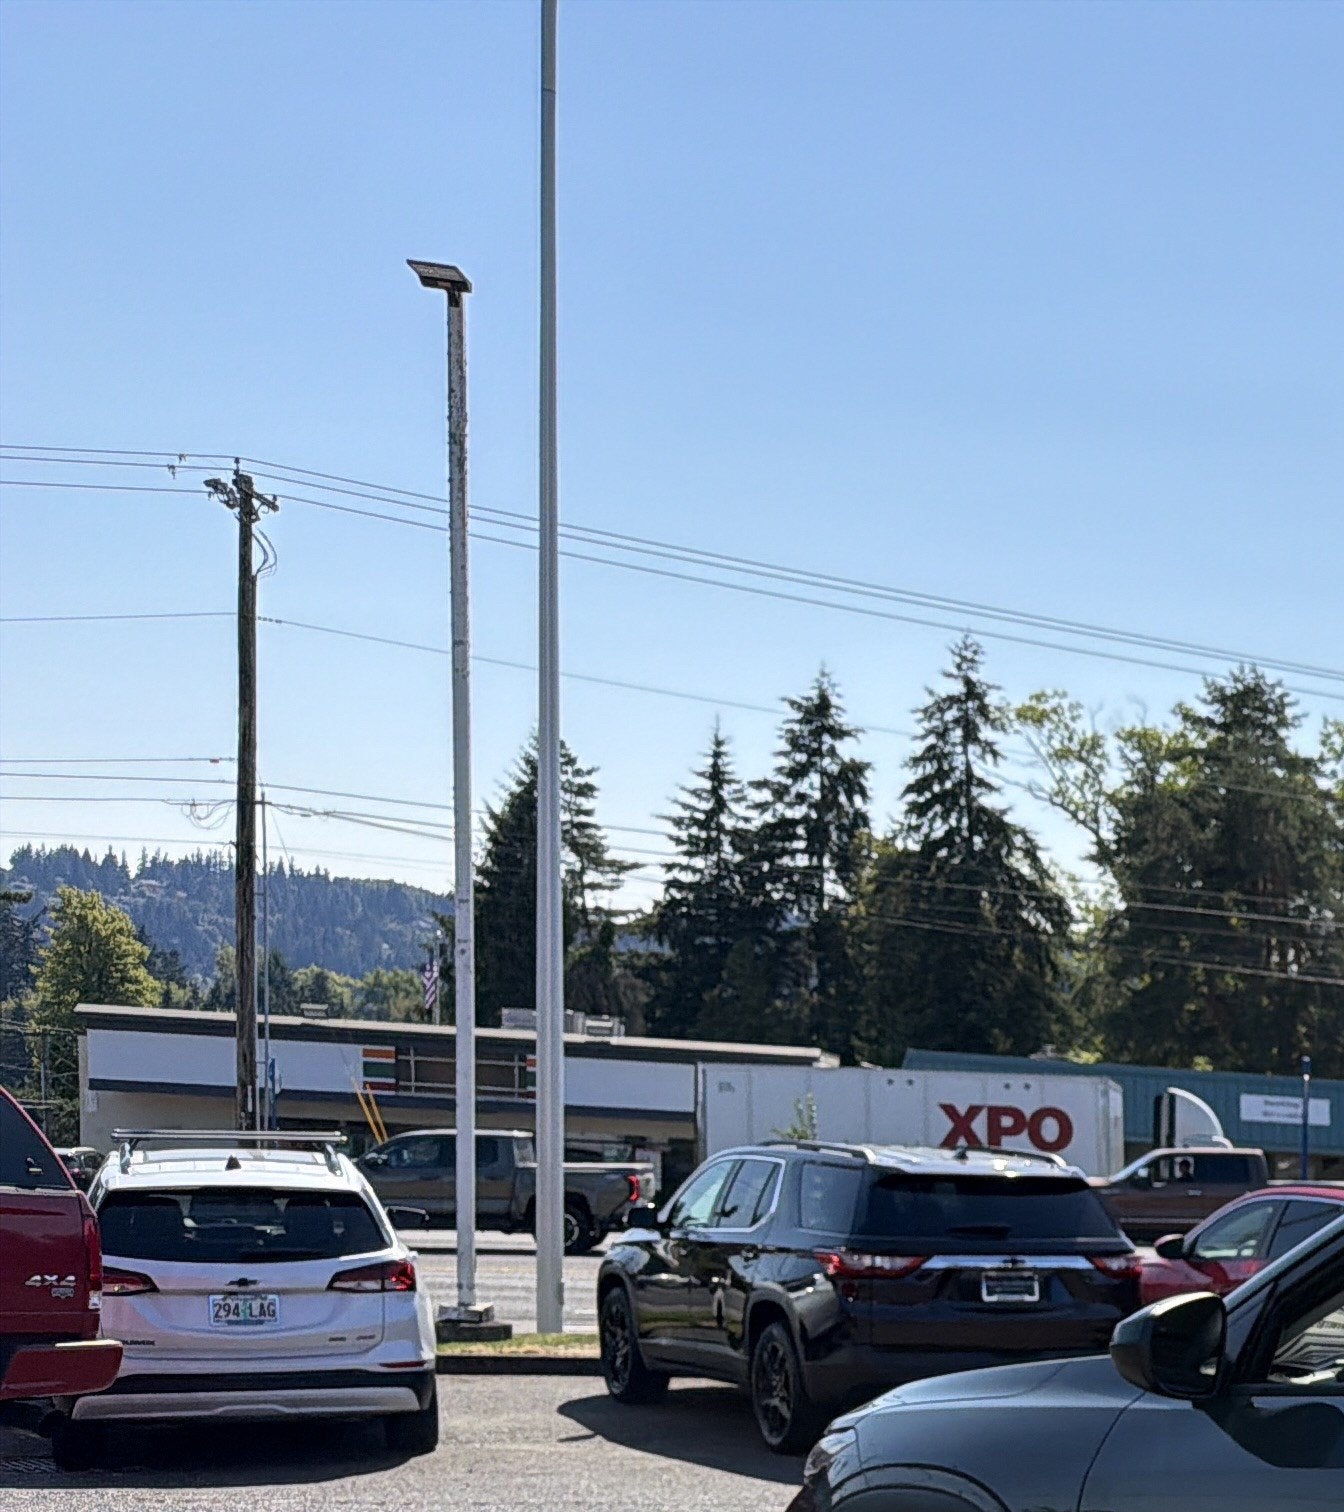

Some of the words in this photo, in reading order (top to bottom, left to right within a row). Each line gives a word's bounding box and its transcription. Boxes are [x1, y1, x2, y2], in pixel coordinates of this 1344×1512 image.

[939, 1103, 1073, 1152] XPO
[214, 1302, 240, 1318] 294
[248, 1302, 276, 1318] LAG
